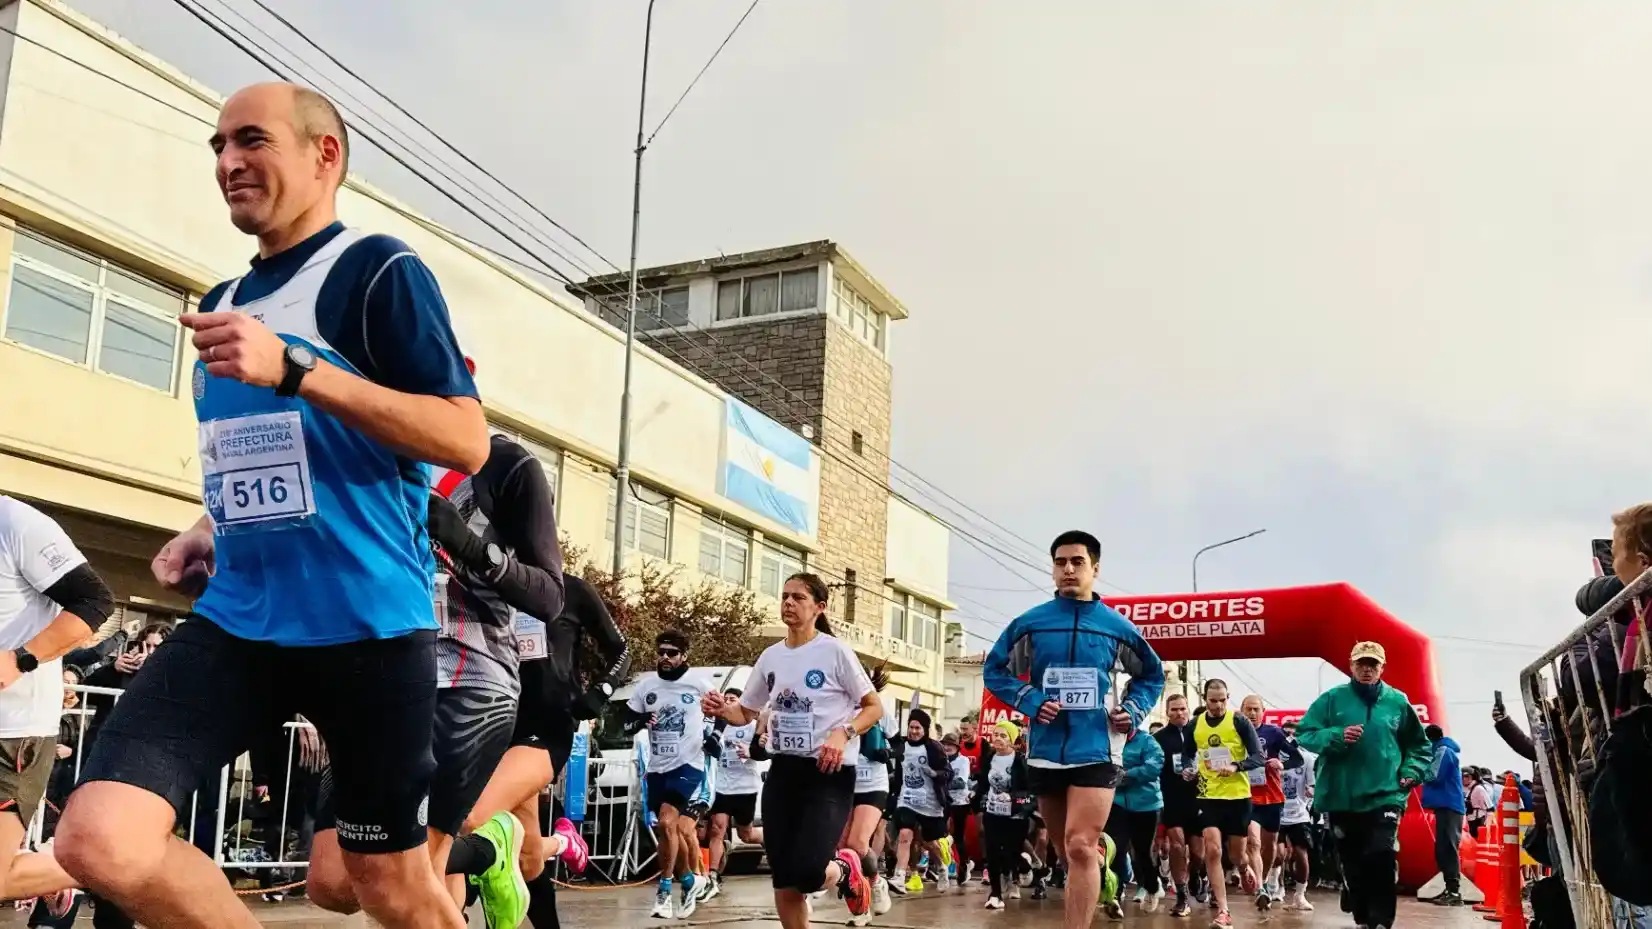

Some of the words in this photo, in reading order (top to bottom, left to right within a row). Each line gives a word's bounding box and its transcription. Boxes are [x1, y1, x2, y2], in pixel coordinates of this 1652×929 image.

[234, 421, 291, 435] ANIVERSARIO
[220, 431, 293, 448] PREFECTURA
[245, 443, 294, 456] ARGENTINA
[233, 476, 287, 508] 516
[1115, 597, 1264, 621] DEPORTES
[1175, 624, 1206, 637] DEL
[1210, 621, 1261, 635] PLATA
[1066, 692, 1089, 703] 877
[784, 737, 805, 749] 512
